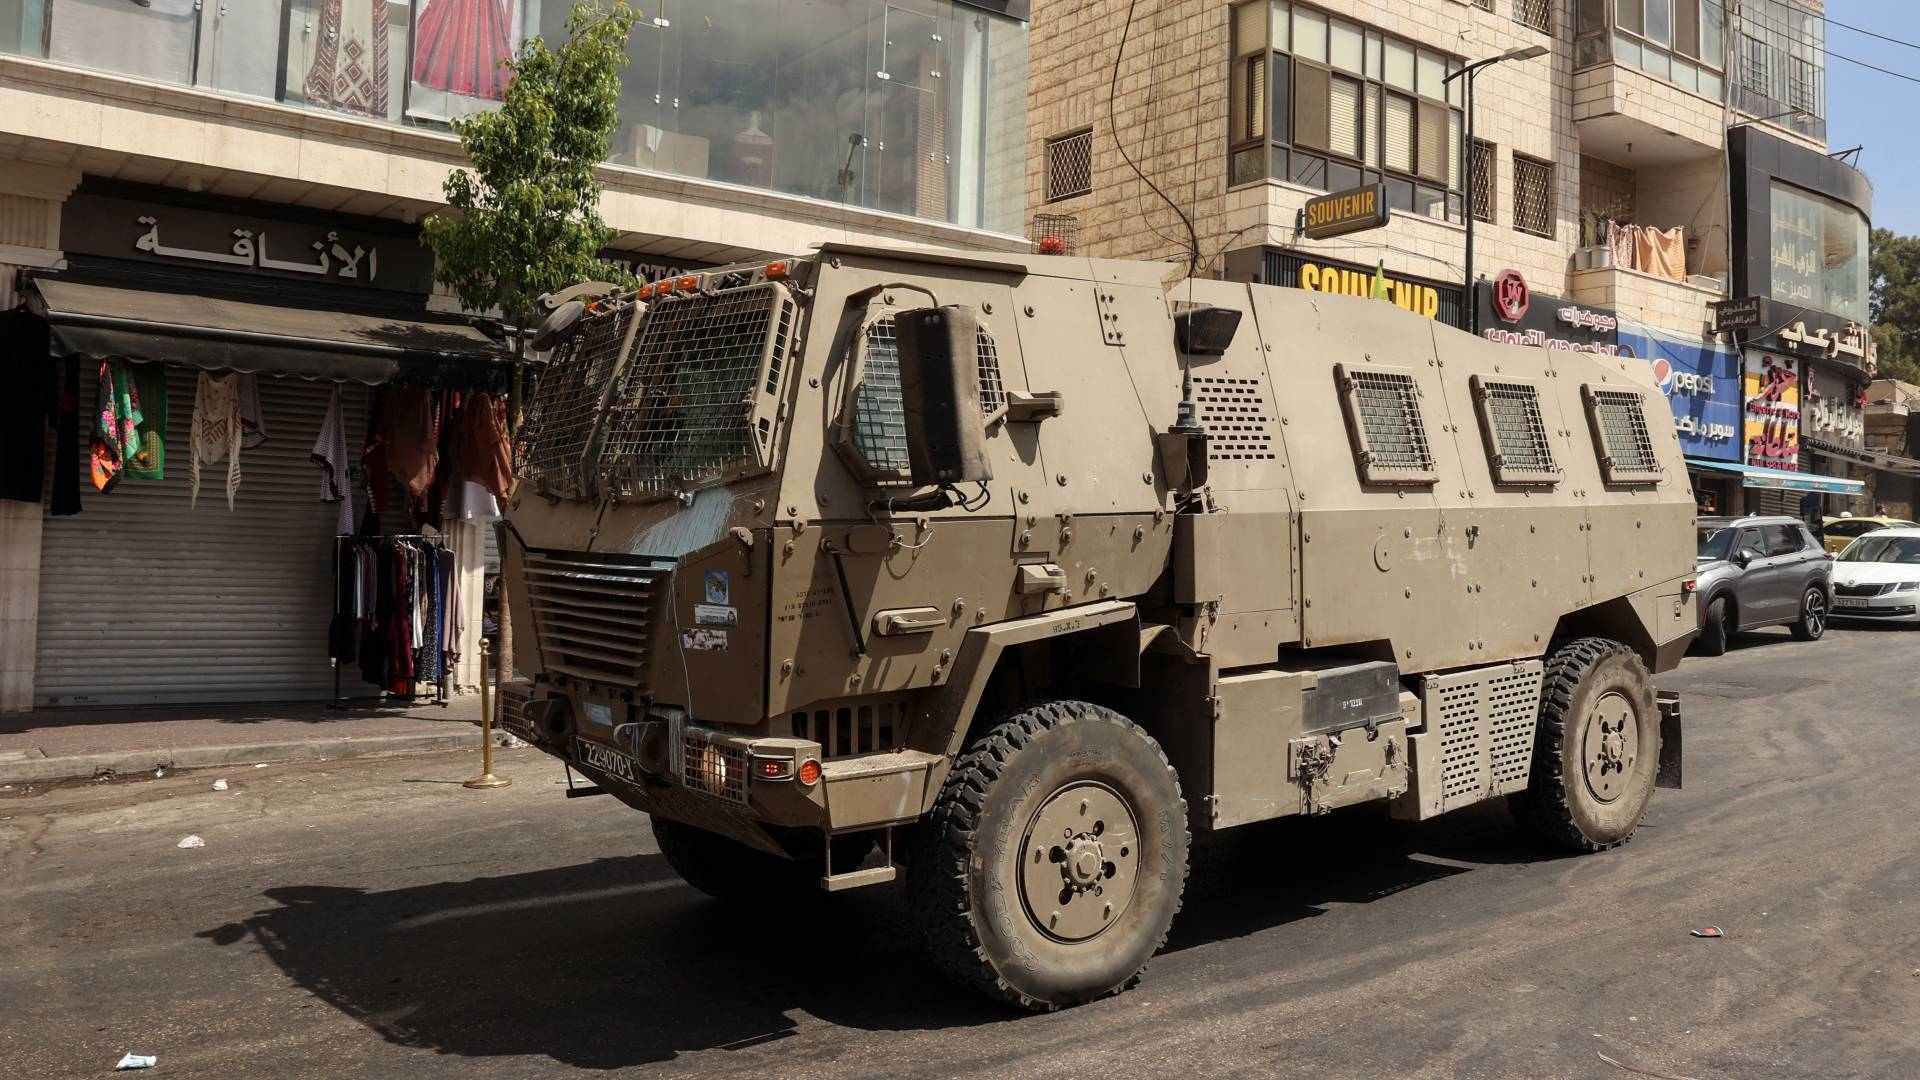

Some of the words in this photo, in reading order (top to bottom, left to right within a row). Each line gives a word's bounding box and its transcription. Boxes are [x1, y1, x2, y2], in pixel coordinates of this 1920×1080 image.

[1309, 191, 1374, 225] SOUVENIR
[136, 215, 377, 281] الأناقة
[1557, 305, 1617, 332] مجوهرات
[1672, 371, 1715, 396] pepsi
